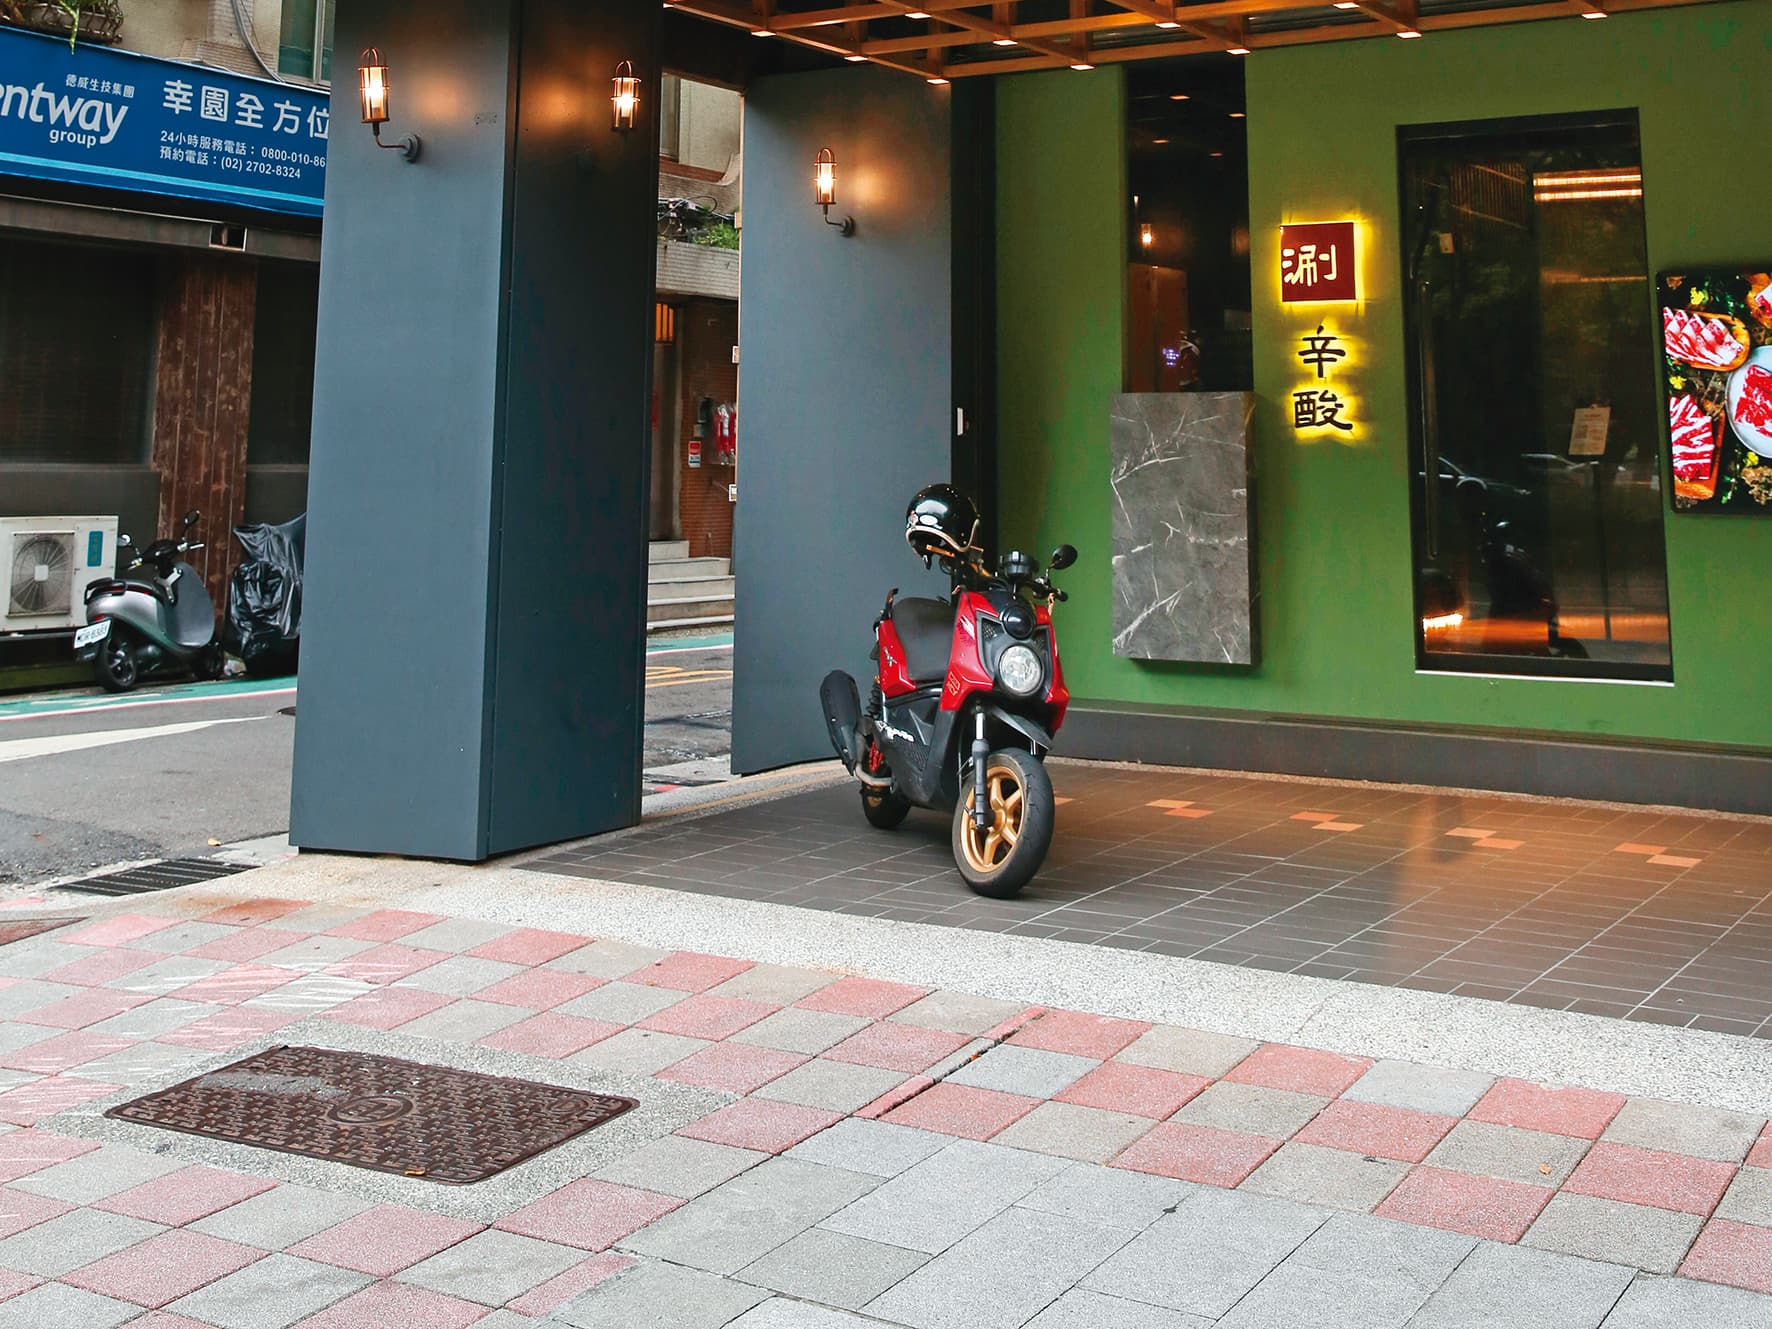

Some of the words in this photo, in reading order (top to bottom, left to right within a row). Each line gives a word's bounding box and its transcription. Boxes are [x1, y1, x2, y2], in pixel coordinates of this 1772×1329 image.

[163, 80, 330, 139] 幸園全方位
[49, 129, 97, 149] group
[261, 146, 326, 168] 0800-010-86
[246, 161, 301, 179] 2702-8324
[1293, 325, 1353, 430] 辛酸
